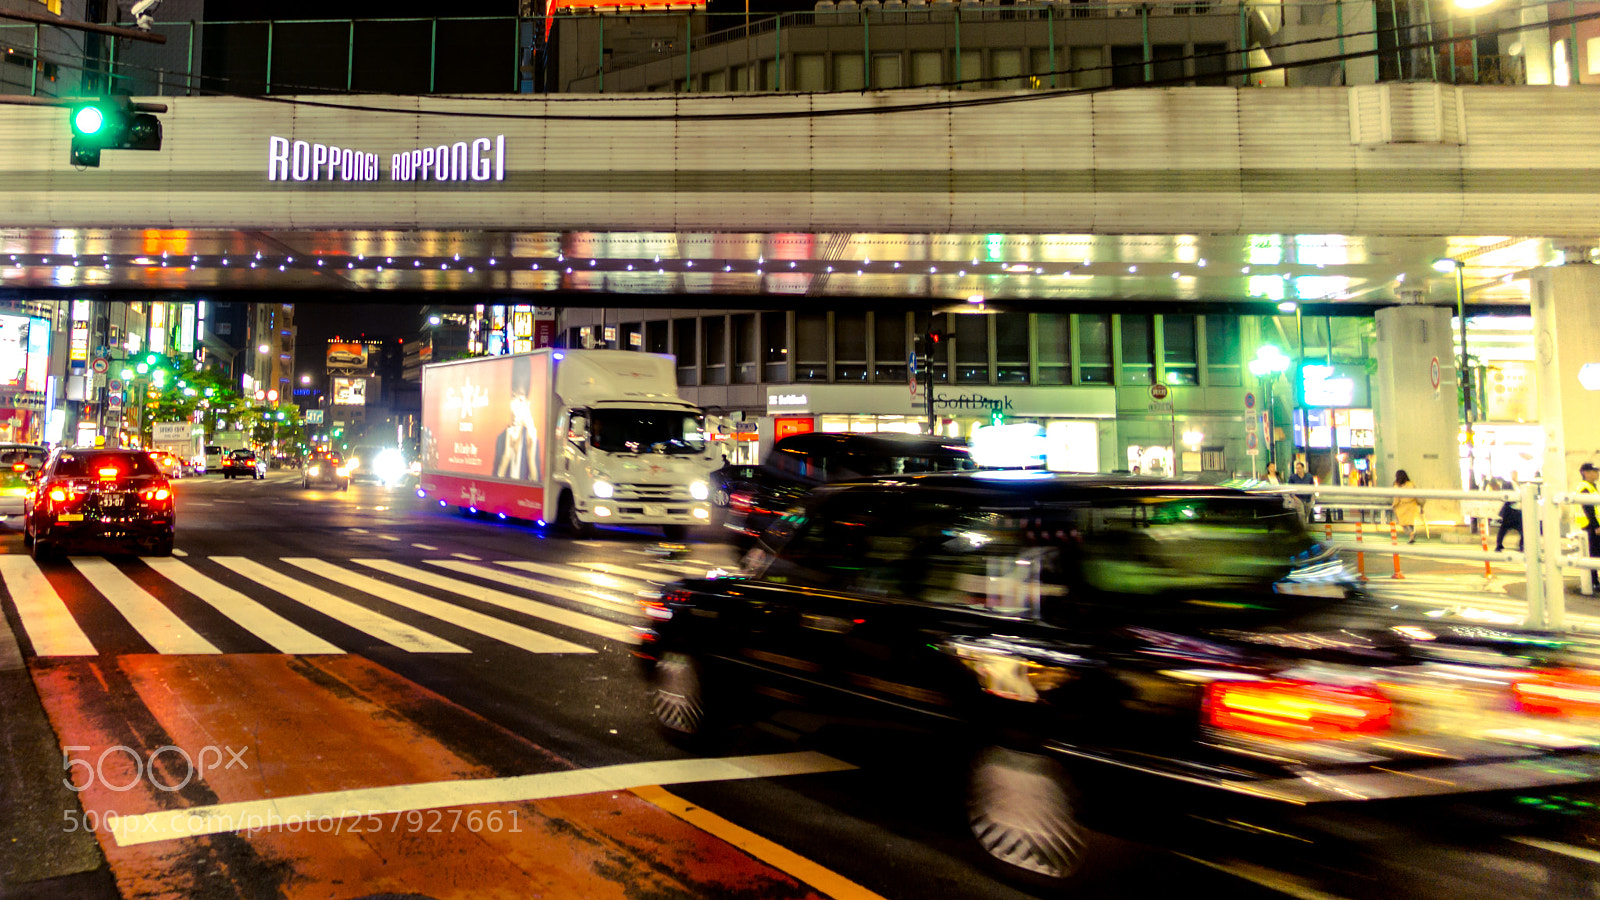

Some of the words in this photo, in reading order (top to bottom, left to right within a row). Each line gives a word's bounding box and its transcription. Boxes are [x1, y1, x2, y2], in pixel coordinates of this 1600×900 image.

[268, 135, 380, 182] ROPPONGI
[391, 134, 506, 182] ROPPONGI
[937, 393, 1014, 410] SoftBank
